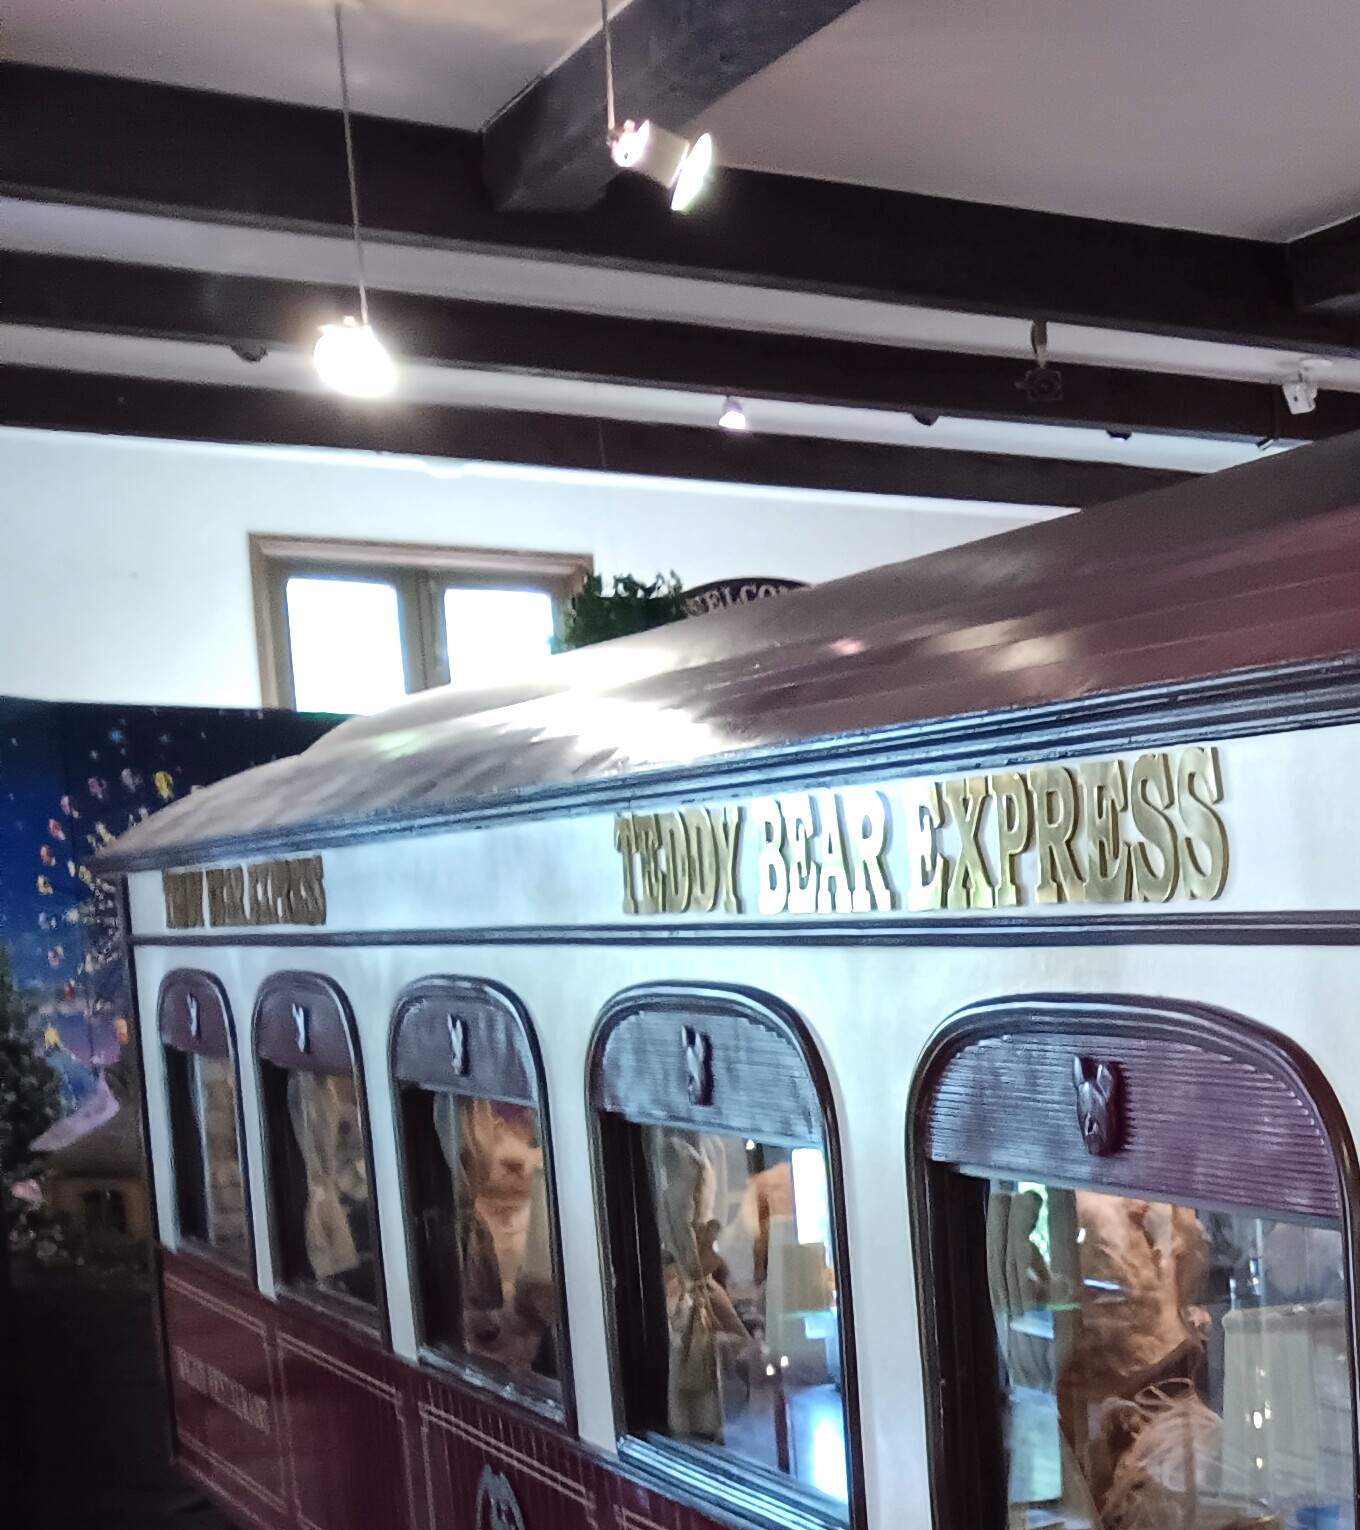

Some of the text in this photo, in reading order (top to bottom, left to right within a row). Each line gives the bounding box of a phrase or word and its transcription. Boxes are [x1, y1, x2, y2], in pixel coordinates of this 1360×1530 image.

[614, 747, 1229, 915] TEDDY BEAR EXPRESS
